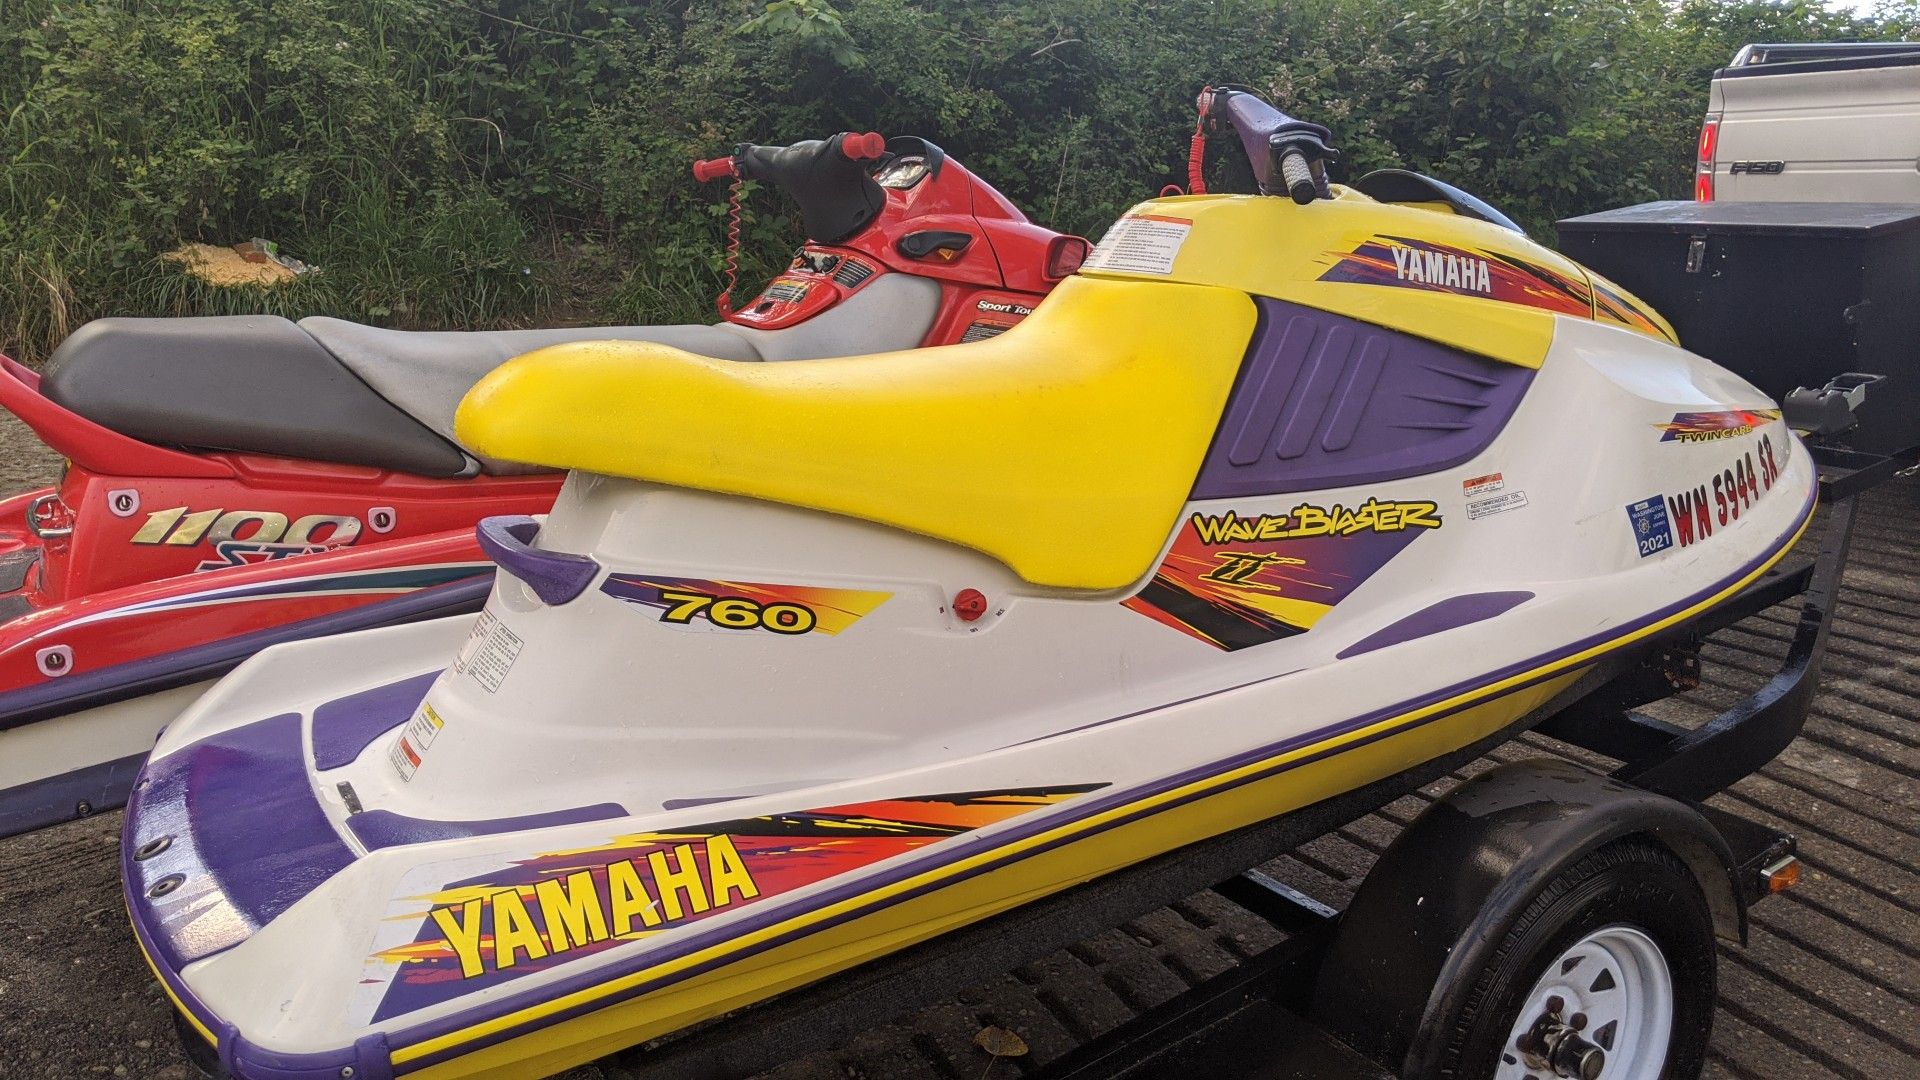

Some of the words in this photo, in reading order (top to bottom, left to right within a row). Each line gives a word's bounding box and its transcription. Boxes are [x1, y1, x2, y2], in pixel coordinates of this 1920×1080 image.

[1390, 245, 1491, 293] YAMAHA
[977, 300, 1011, 312] Sport
[1668, 484, 1712, 547] WN
[1712, 452, 1759, 526] 5944
[1758, 433, 1777, 491] SR
[129, 506, 361, 547] 1100
[1641, 532, 1670, 554] 2021
[659, 588, 817, 635] 760
[428, 833, 760, 980] YAMAHA
